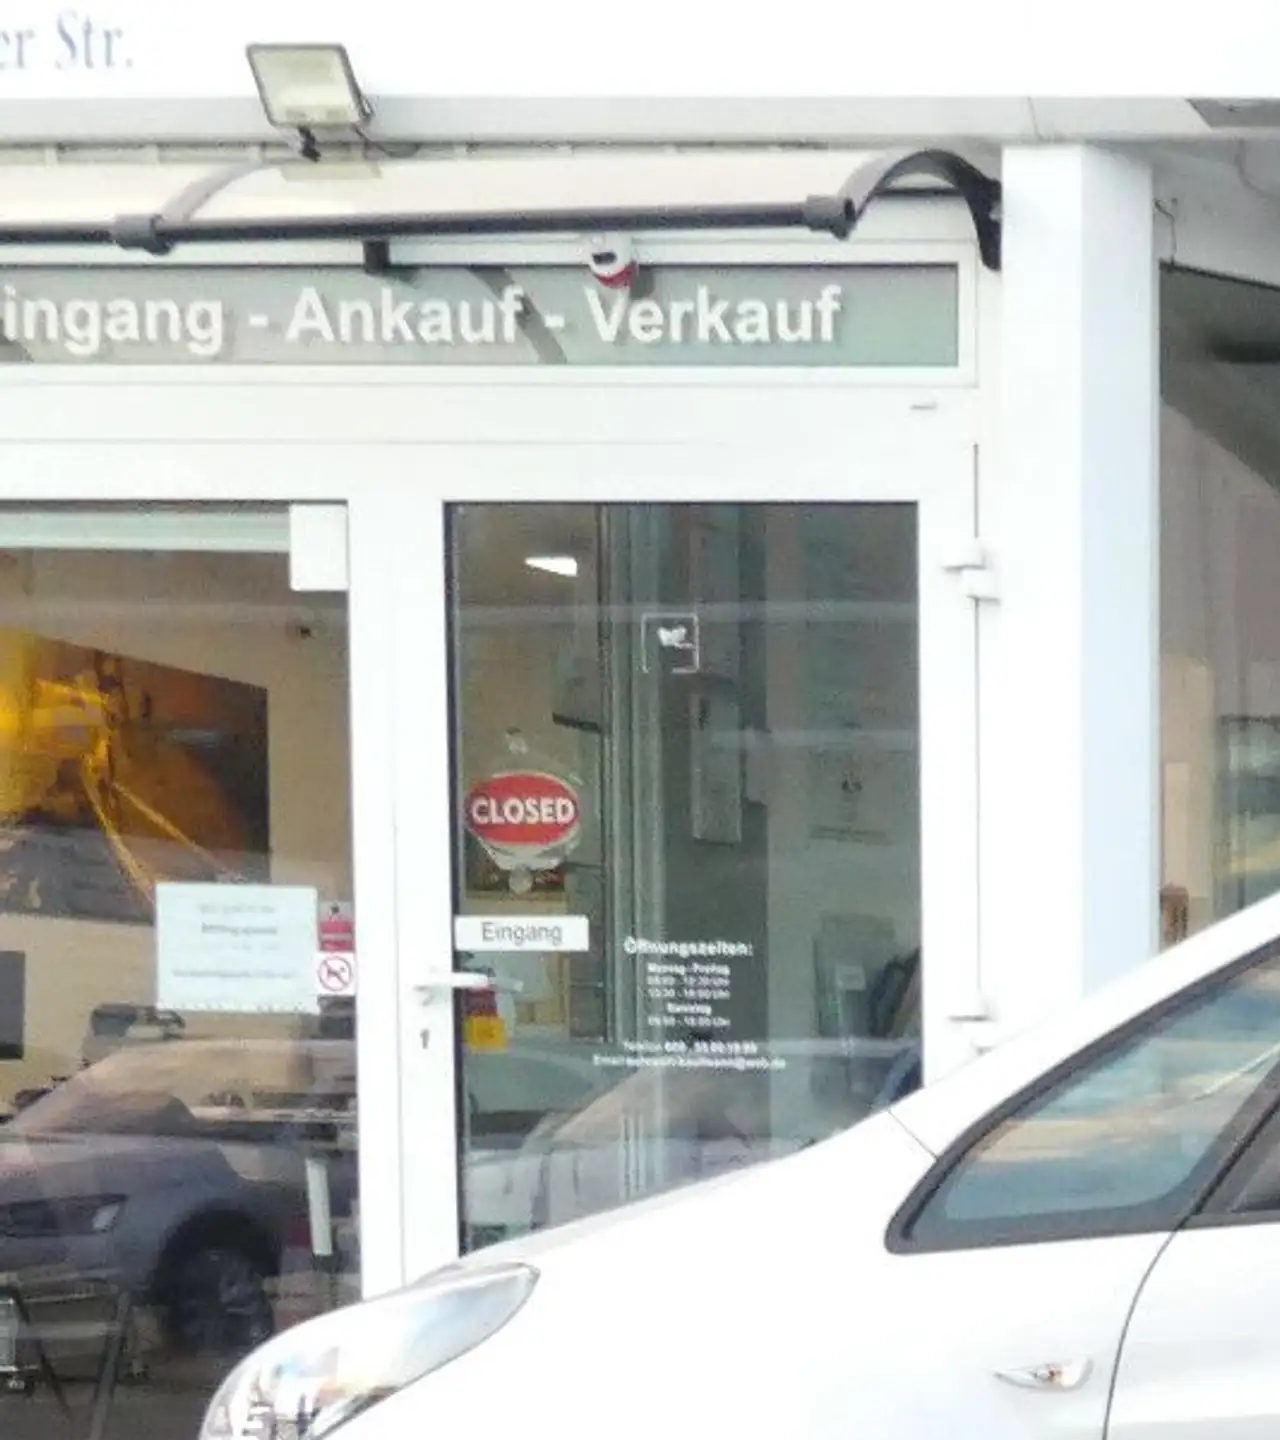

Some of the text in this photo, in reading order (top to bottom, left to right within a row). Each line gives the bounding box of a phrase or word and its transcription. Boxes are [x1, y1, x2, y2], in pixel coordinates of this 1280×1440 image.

[53, 6, 134, 71] Str.
[285, 285, 528, 344] Ankauf
[586, 284, 843, 344] Verkauf
[471, 796, 576, 826] CLOSED
[480, 921, 564, 947] Eingang
